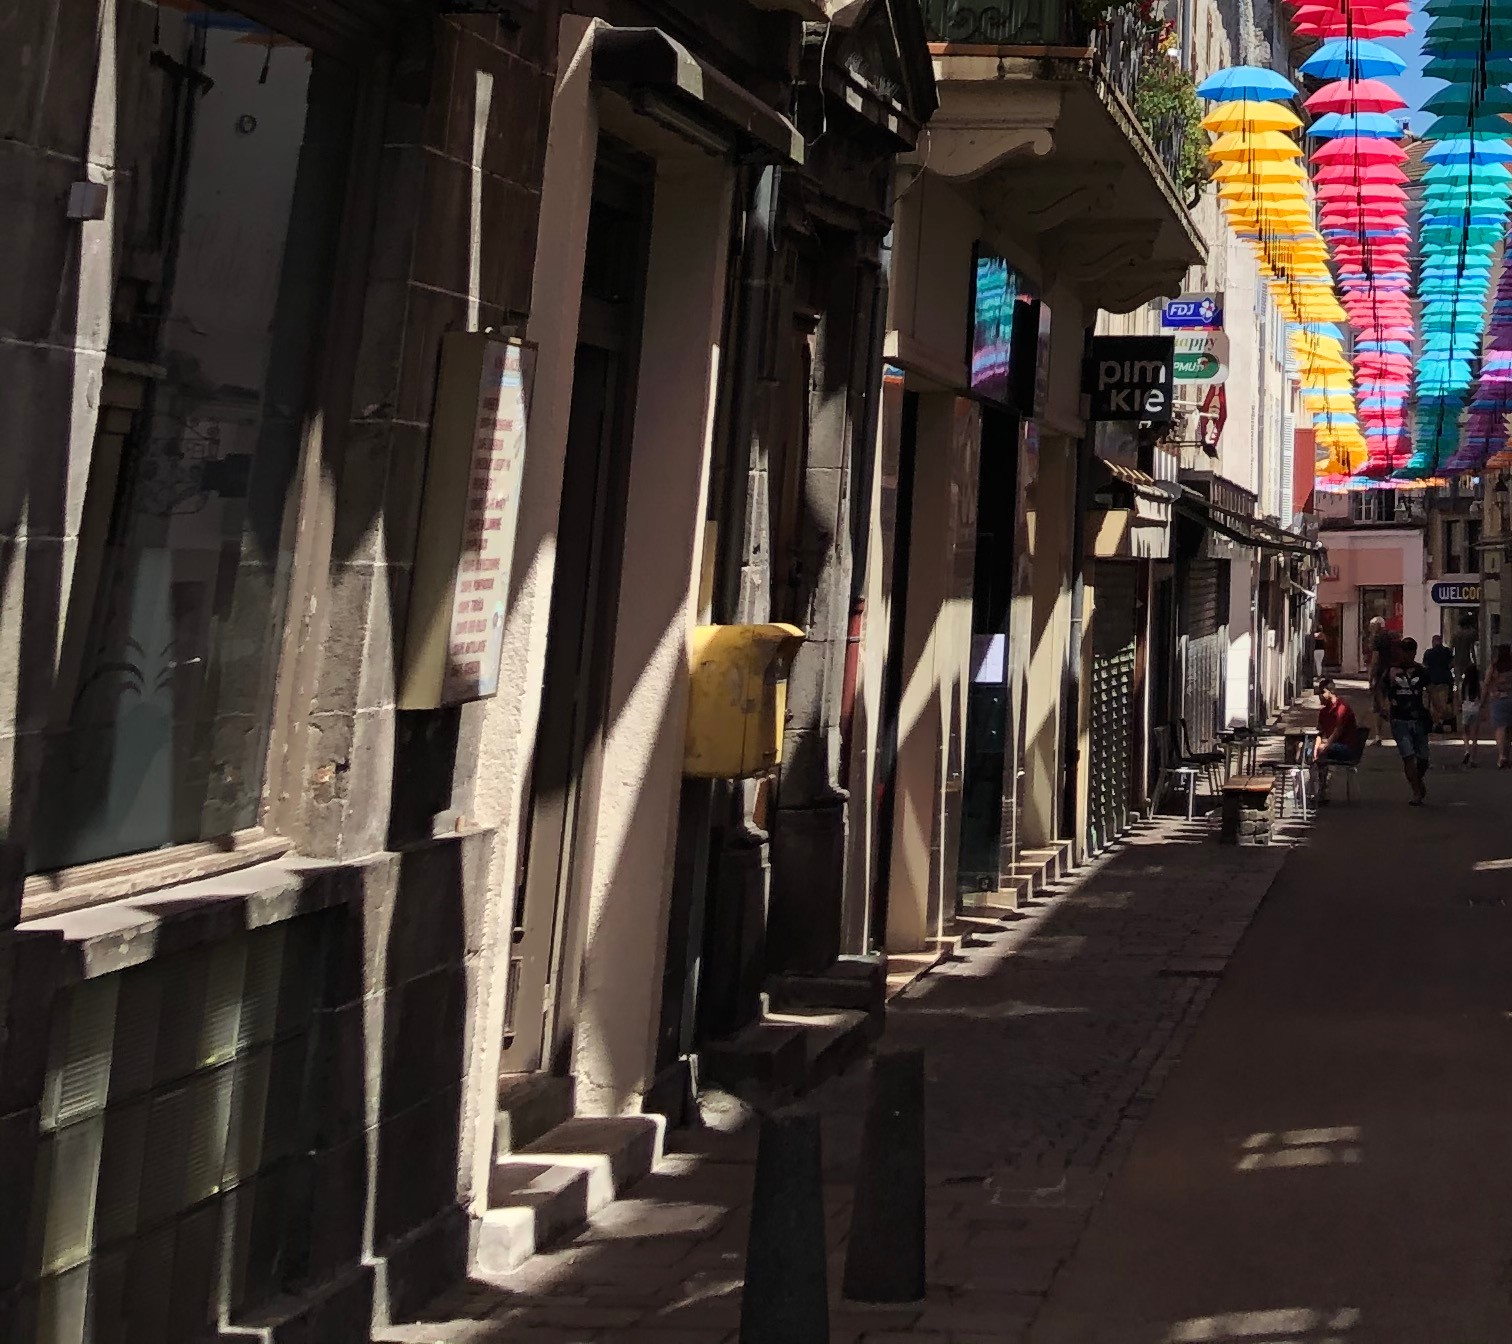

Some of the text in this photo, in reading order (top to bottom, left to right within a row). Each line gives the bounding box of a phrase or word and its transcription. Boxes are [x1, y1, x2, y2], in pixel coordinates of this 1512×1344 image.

[1169, 304, 1195, 316] FDJ
[1174, 361, 1196, 372] PMU
[1099, 360, 1166, 391] pim
[1110, 389, 1166, 412] kie
